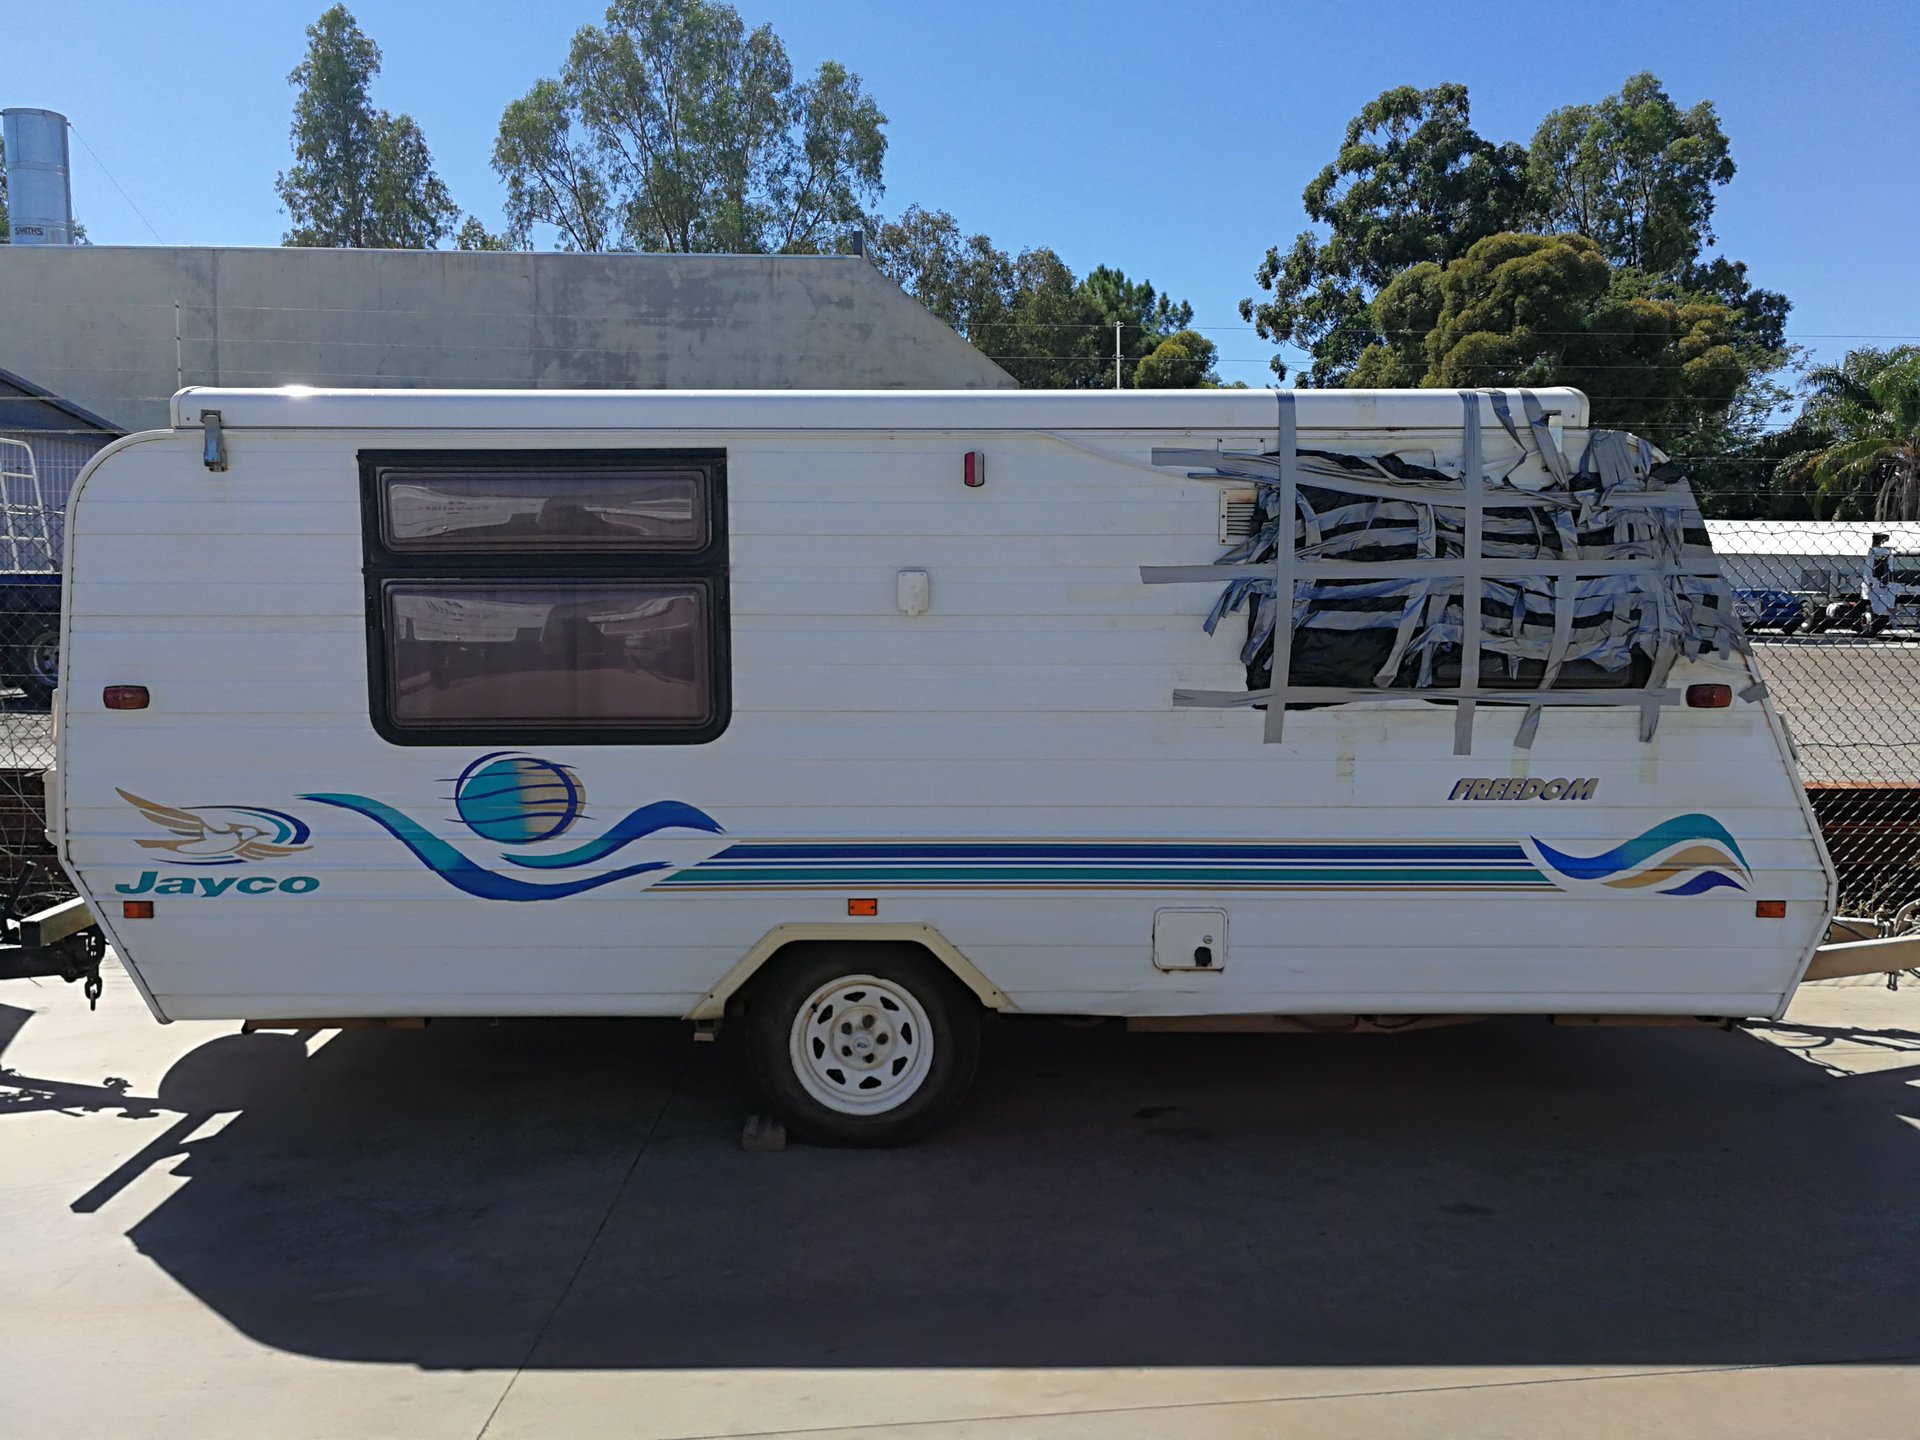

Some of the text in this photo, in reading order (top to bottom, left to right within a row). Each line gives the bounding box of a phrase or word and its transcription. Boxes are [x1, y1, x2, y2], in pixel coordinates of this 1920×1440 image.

[15, 226, 43, 235] SMITHS
[1448, 778, 1599, 800] FREEDOM
[115, 871, 320, 897] Jayco
